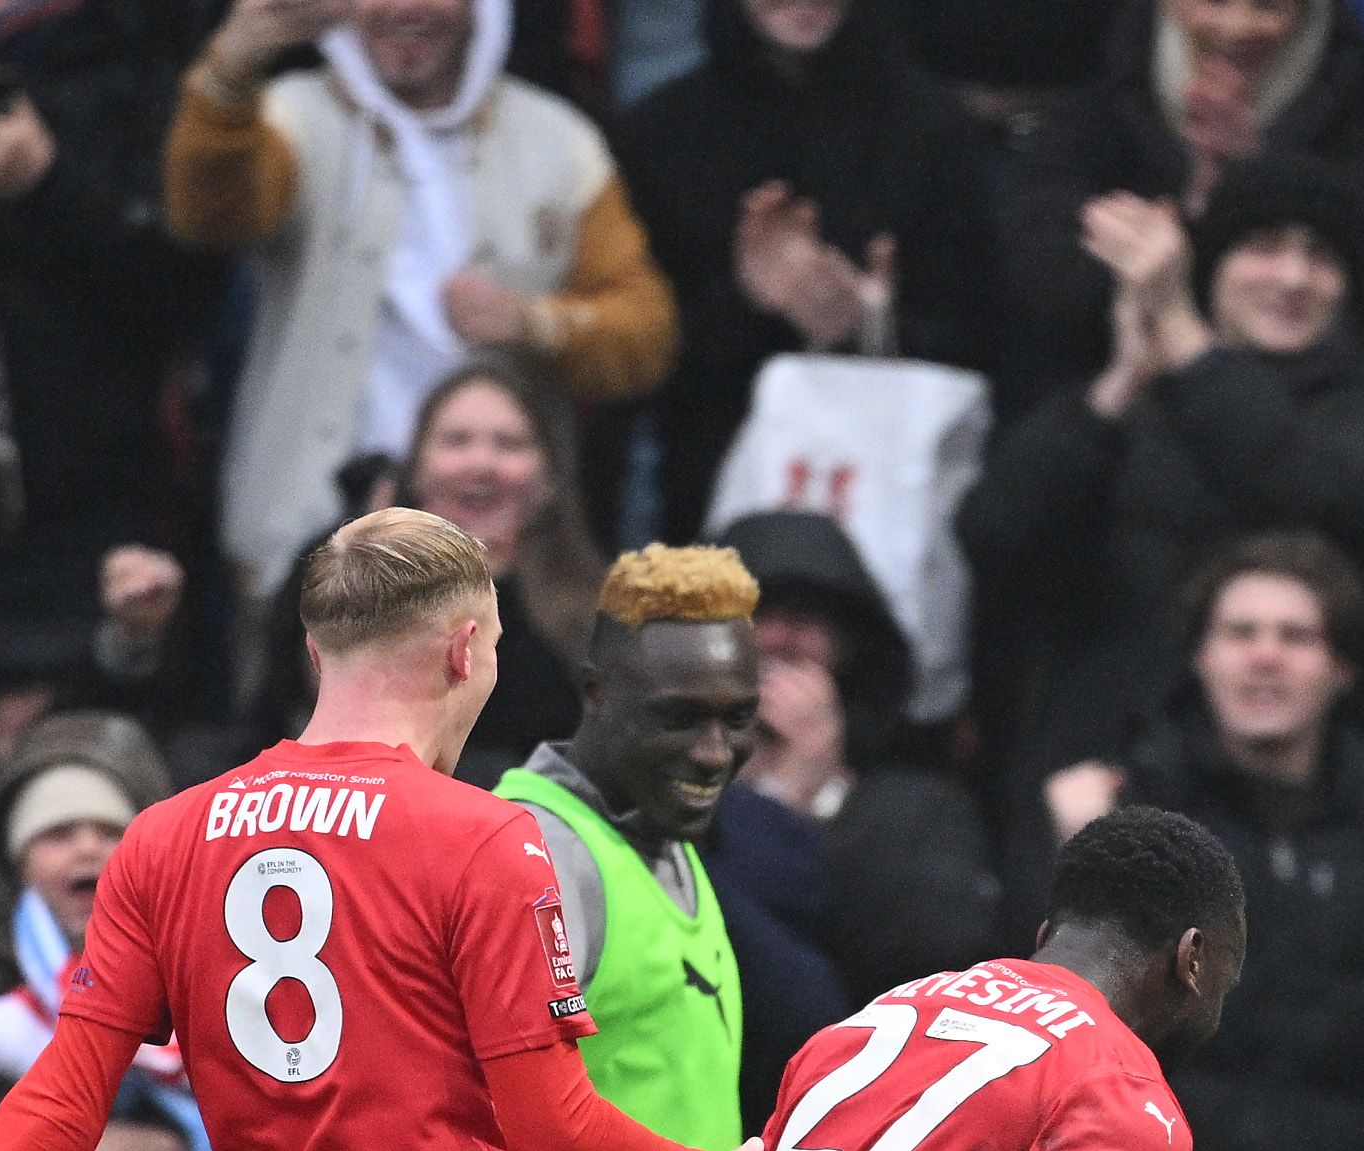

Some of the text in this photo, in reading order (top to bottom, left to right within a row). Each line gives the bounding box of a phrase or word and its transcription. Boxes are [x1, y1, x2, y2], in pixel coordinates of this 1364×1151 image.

[290, 771, 346, 783] Kingston
[349, 775, 385, 785] Smith
[205, 783, 386, 842] BROWN
[223, 847, 343, 1083] 8
[287, 1067, 301, 1076] EFL
